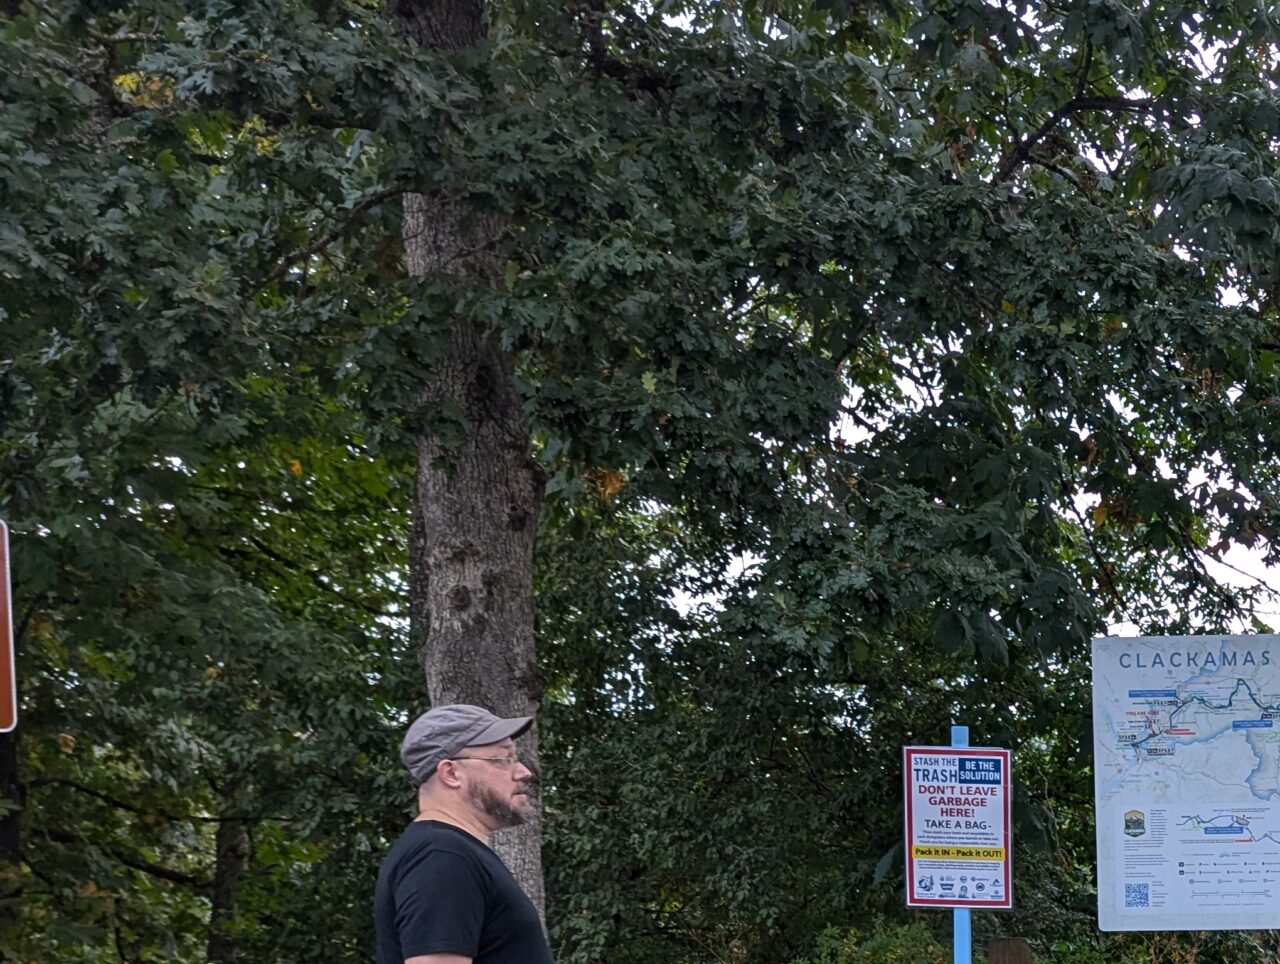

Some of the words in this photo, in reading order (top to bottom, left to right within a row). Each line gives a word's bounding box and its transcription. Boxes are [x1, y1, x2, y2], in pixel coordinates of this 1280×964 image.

[1119, 650, 1270, 669] CLACKAMAS
[913, 757, 939, 766] STASH
[941, 758, 957, 766] THE
[965, 761, 977, 770] BE
[978, 761, 995, 770] THE
[913, 768, 958, 783] TRASH
[959, 771, 1000, 781] SOLUTION
[918, 785, 956, 795] DON'T
[960, 786, 997, 796] LEAVE
[928, 796, 987, 807] GARBAGE
[940, 807, 975, 817] HERE!
[924, 819, 951, 829] TAKE
[954, 820, 962, 829] A
[965, 821, 987, 830] BAG
[982, 850, 1002, 858] OUT!
